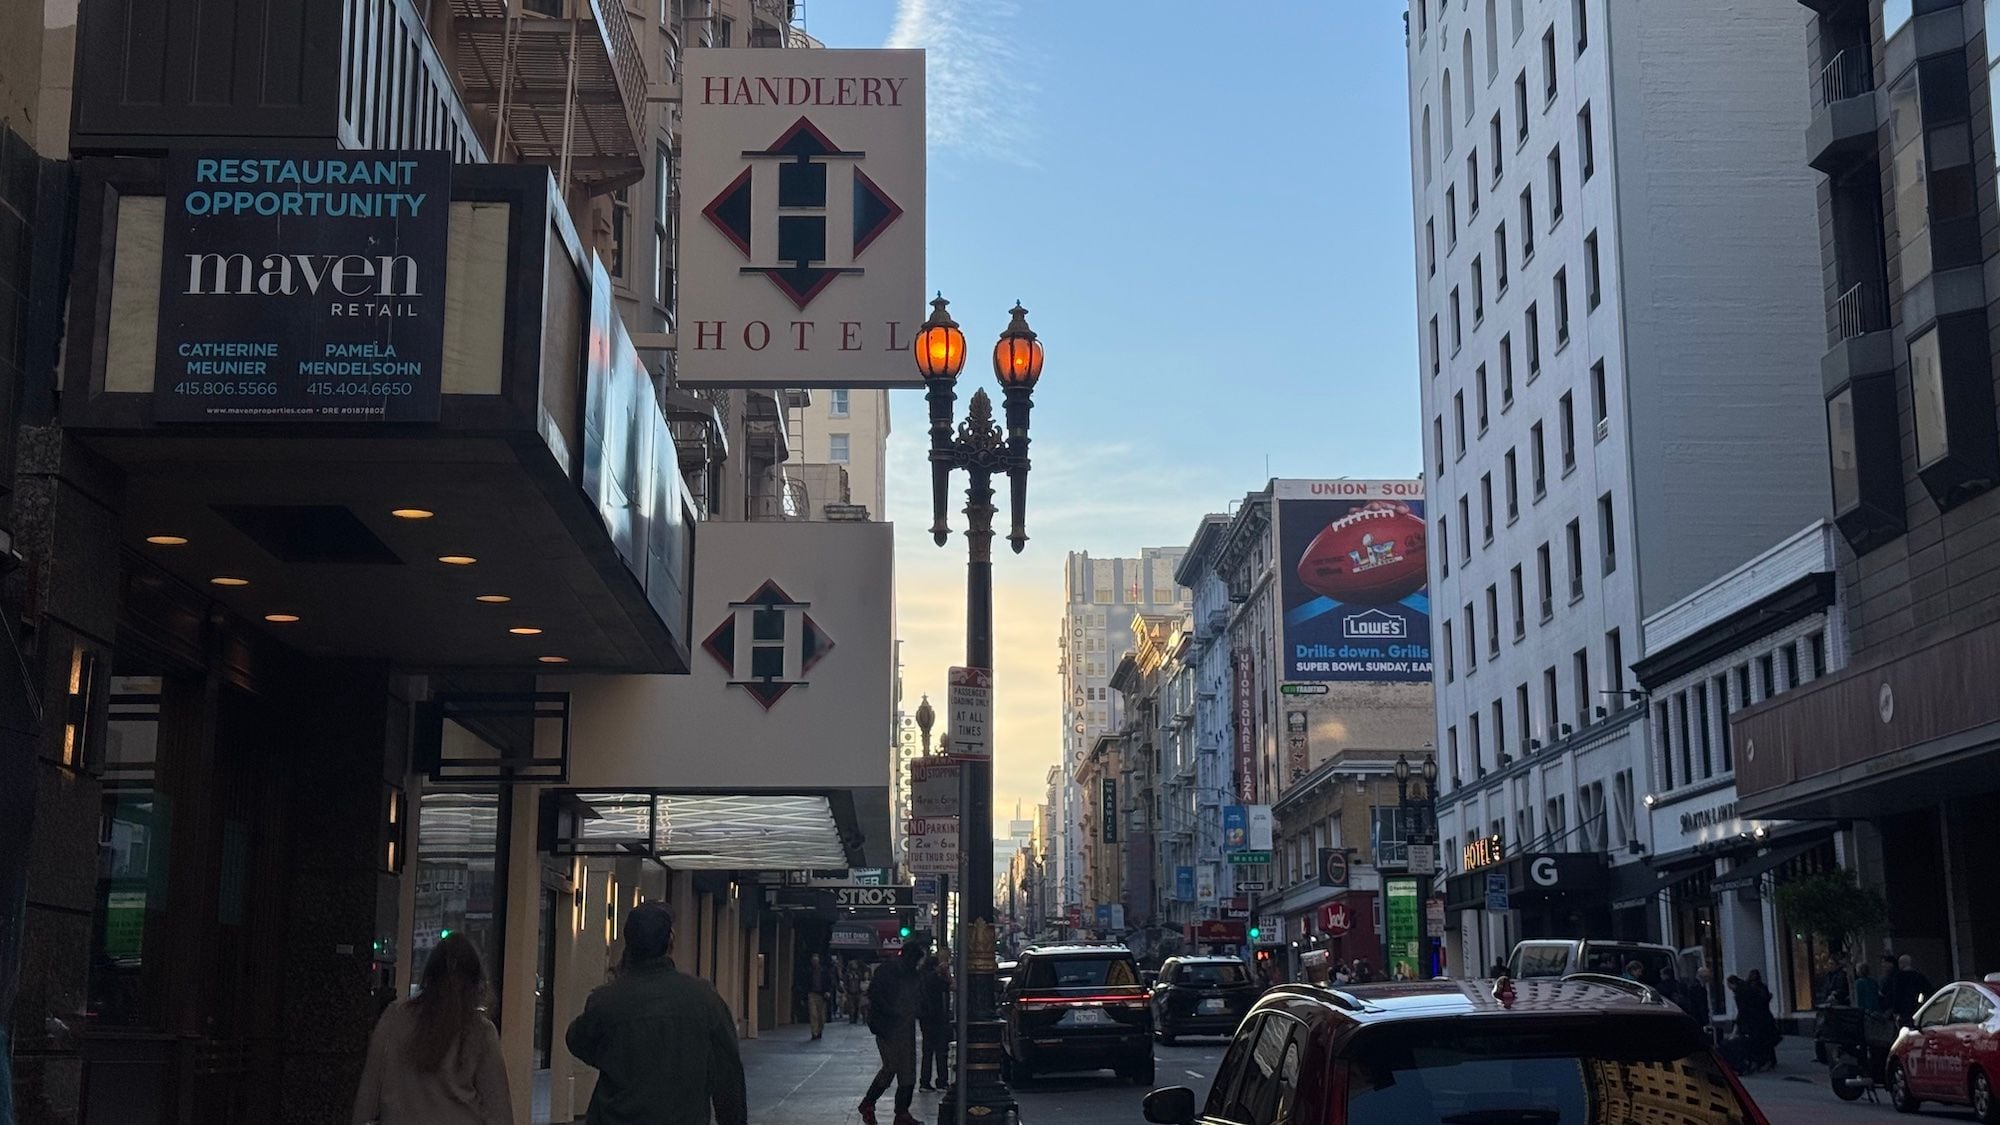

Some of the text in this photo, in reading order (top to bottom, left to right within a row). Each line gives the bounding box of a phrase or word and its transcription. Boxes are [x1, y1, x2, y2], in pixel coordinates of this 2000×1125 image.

[700, 76, 908, 107] HANDLERY
[197, 159, 418, 185] RESTAURANT
[185, 191, 426, 217] OPPORTUNITY
[182, 253, 423, 296] maven
[331, 303, 418, 317] RETAIL
[693, 320, 910, 351] HOTEL
[178, 343, 278, 357] CATHERINE
[325, 343, 396, 358] PAMELA
[187, 361, 267, 375] MEUNIER
[299, 362, 422, 376] MENDELSOHN
[174, 381, 278, 396] 415.806.5566
[306, 382, 412, 396] 415.404.6650
[206, 406, 314, 416] www.mavenproperties.com
[1311, 483, 1367, 495] UNION
[1350, 619, 1400, 634] LOWE'S
[1074, 615, 1083, 675] HOTEL
[1296, 644, 1429, 659] Drills down. Grills
[1240, 654, 1250, 696] UNION
[1296, 662, 1330, 672] SUPER
[1332, 662, 1364, 672] BOWL
[1366, 662, 1411, 673] SUNDAY,
[956, 711, 984, 723] AT ALL
[958, 725, 982, 737] TIMES
[1241, 701, 1251, 752] SQUARE
[913, 766, 926, 781] NO
[1242, 758, 1252, 801] PLAZA
[1105, 787, 1114, 839] WARWICK
[910, 820, 925, 835] NO
[911, 852, 923, 862] TUE
[1463, 838, 1492, 871] HOTEL
[1531, 857, 1559, 886] G
[831, 888, 897, 905] STRO'S
[1259, 918, 1277, 927] IZZA
[1327, 905, 1350, 931] Jack
